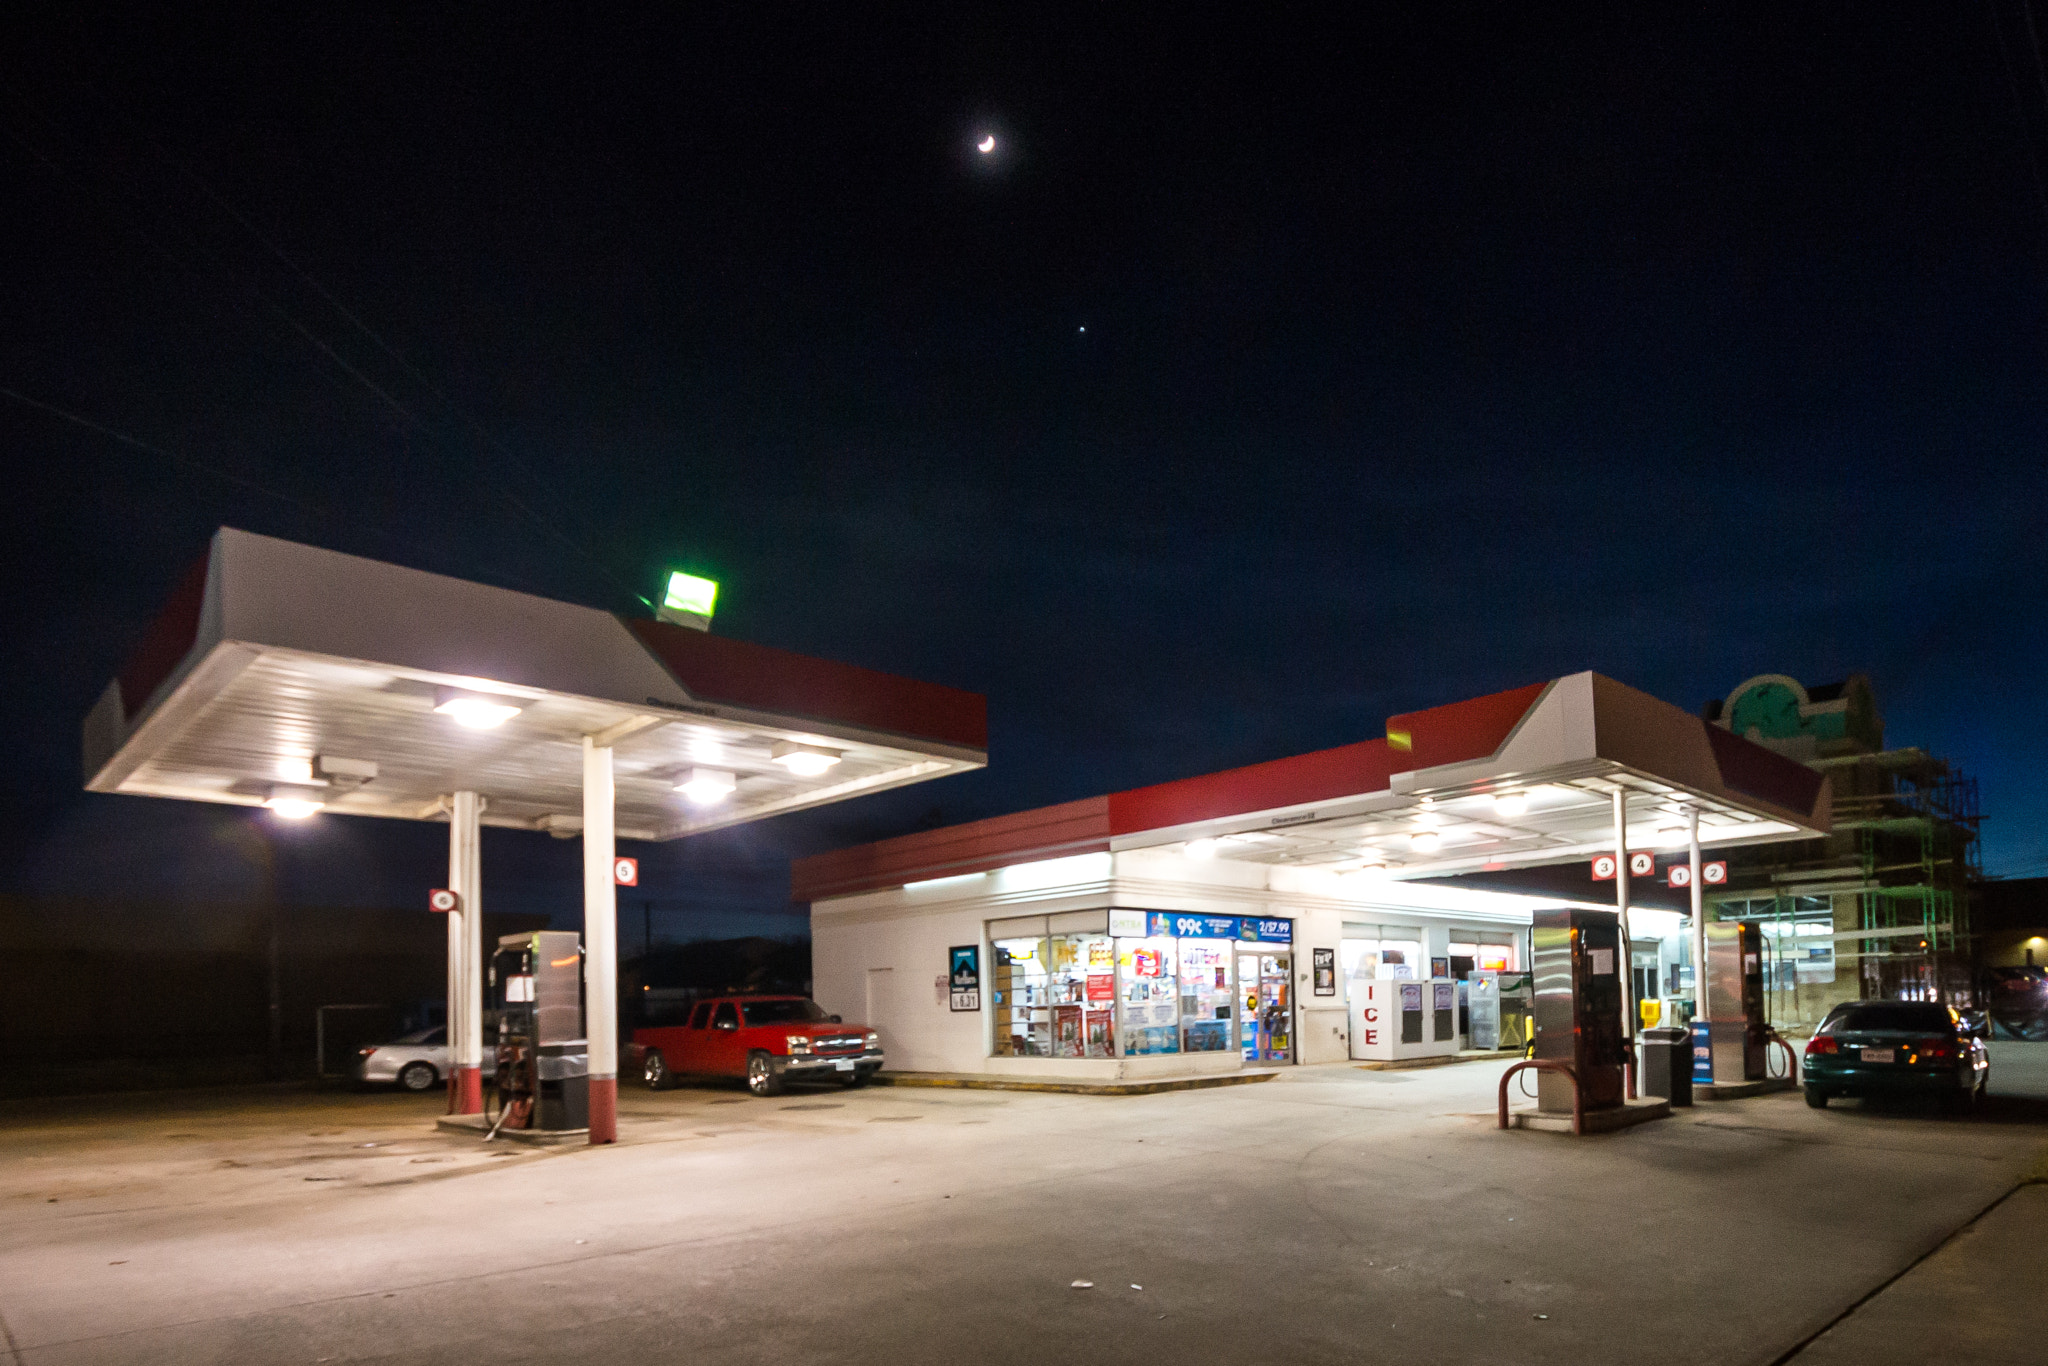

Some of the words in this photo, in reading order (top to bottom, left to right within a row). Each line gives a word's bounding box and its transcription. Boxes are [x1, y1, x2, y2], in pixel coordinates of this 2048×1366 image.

[1601, 863, 1608, 872] 3
[1637, 859, 1645, 868] 4
[620, 866, 628, 876] 5
[1709, 869, 1718, 877] 2
[1677, 872, 1682, 880] 1
[1364, 985, 1378, 1045] ICE
